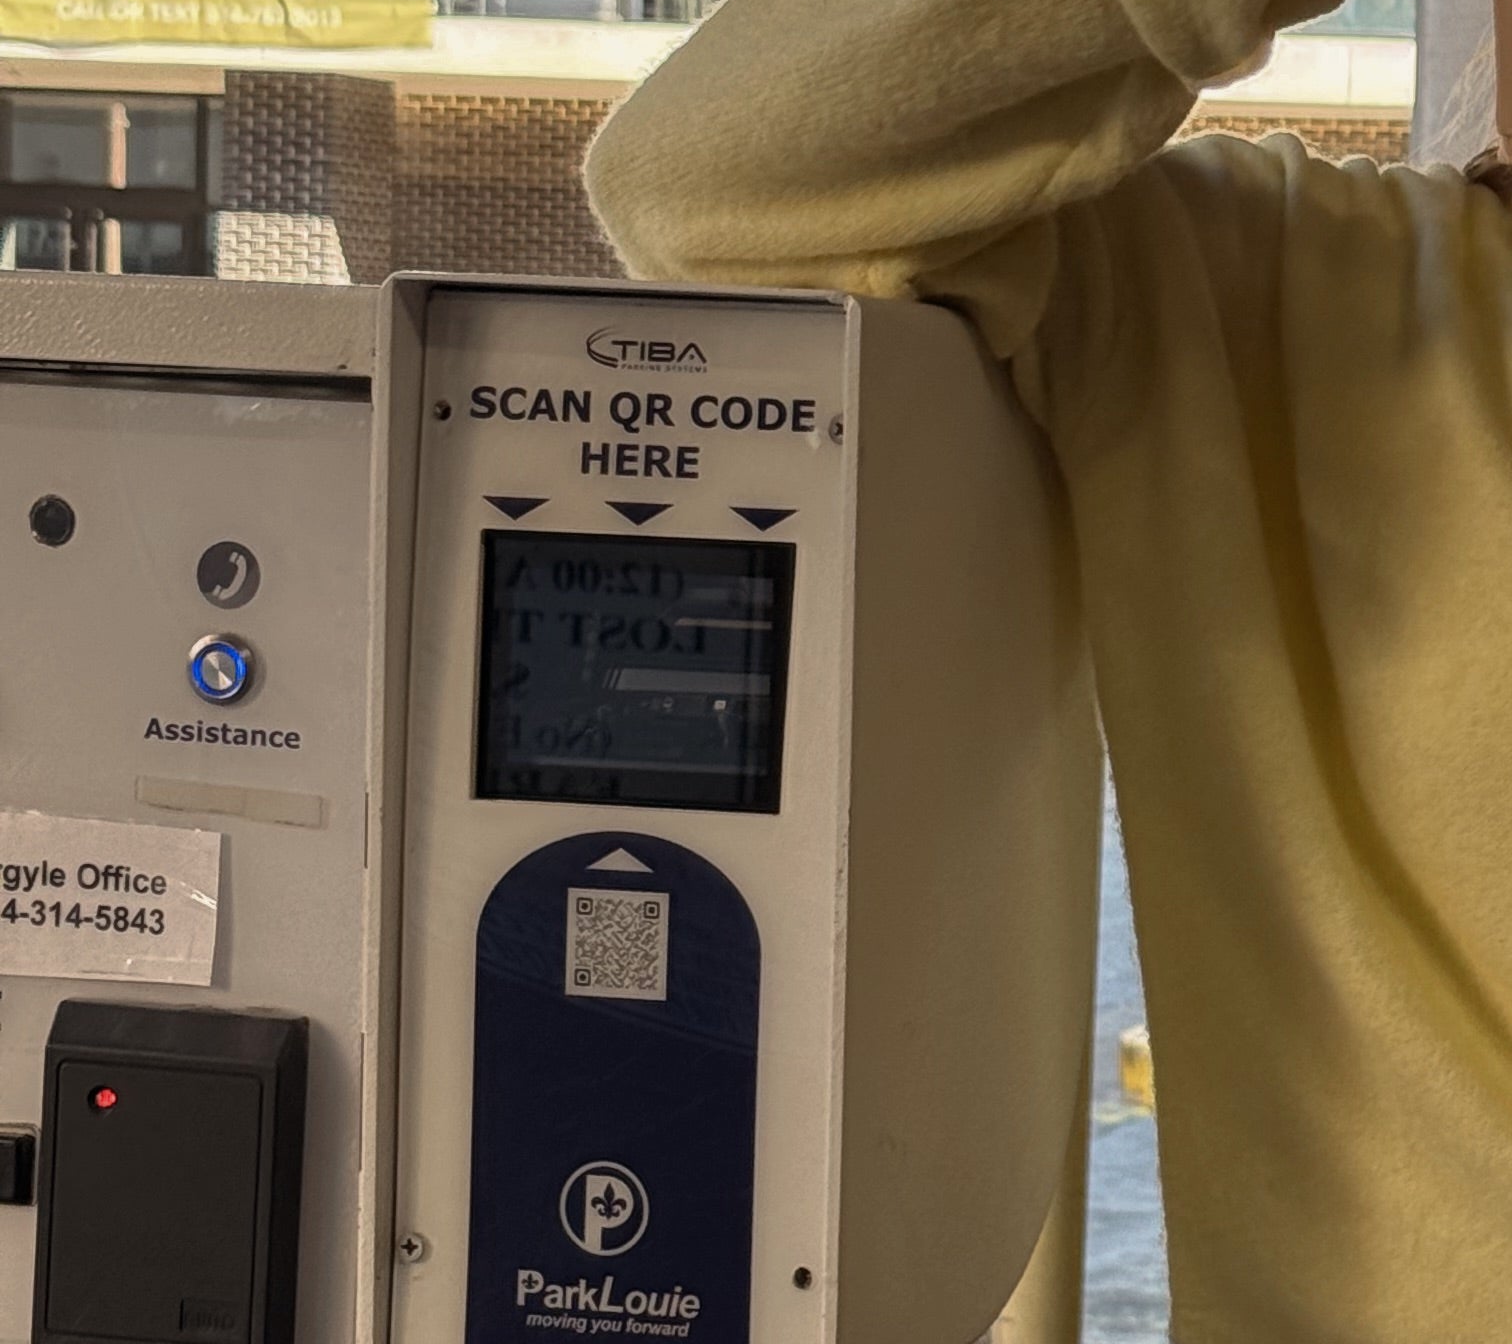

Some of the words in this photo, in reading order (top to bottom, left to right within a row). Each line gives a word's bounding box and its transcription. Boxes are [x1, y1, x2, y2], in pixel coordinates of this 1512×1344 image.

[611, 340, 708, 364] TIBA
[470, 386, 591, 423] SCAN
[609, 391, 675, 434] QR
[691, 395, 816, 433] CODE
[581, 442, 700, 479] HERE
[143, 717, 301, 749] Assistance
[77, 863, 167, 895] Office
[0, 898, 165, 935] 4-314-5843
[516, 1269, 700, 1319] ParkLouie
[525, 1313, 587, 1333] moving
[589, 1318, 622, 1335] you
[626, 1317, 690, 1337] forward
